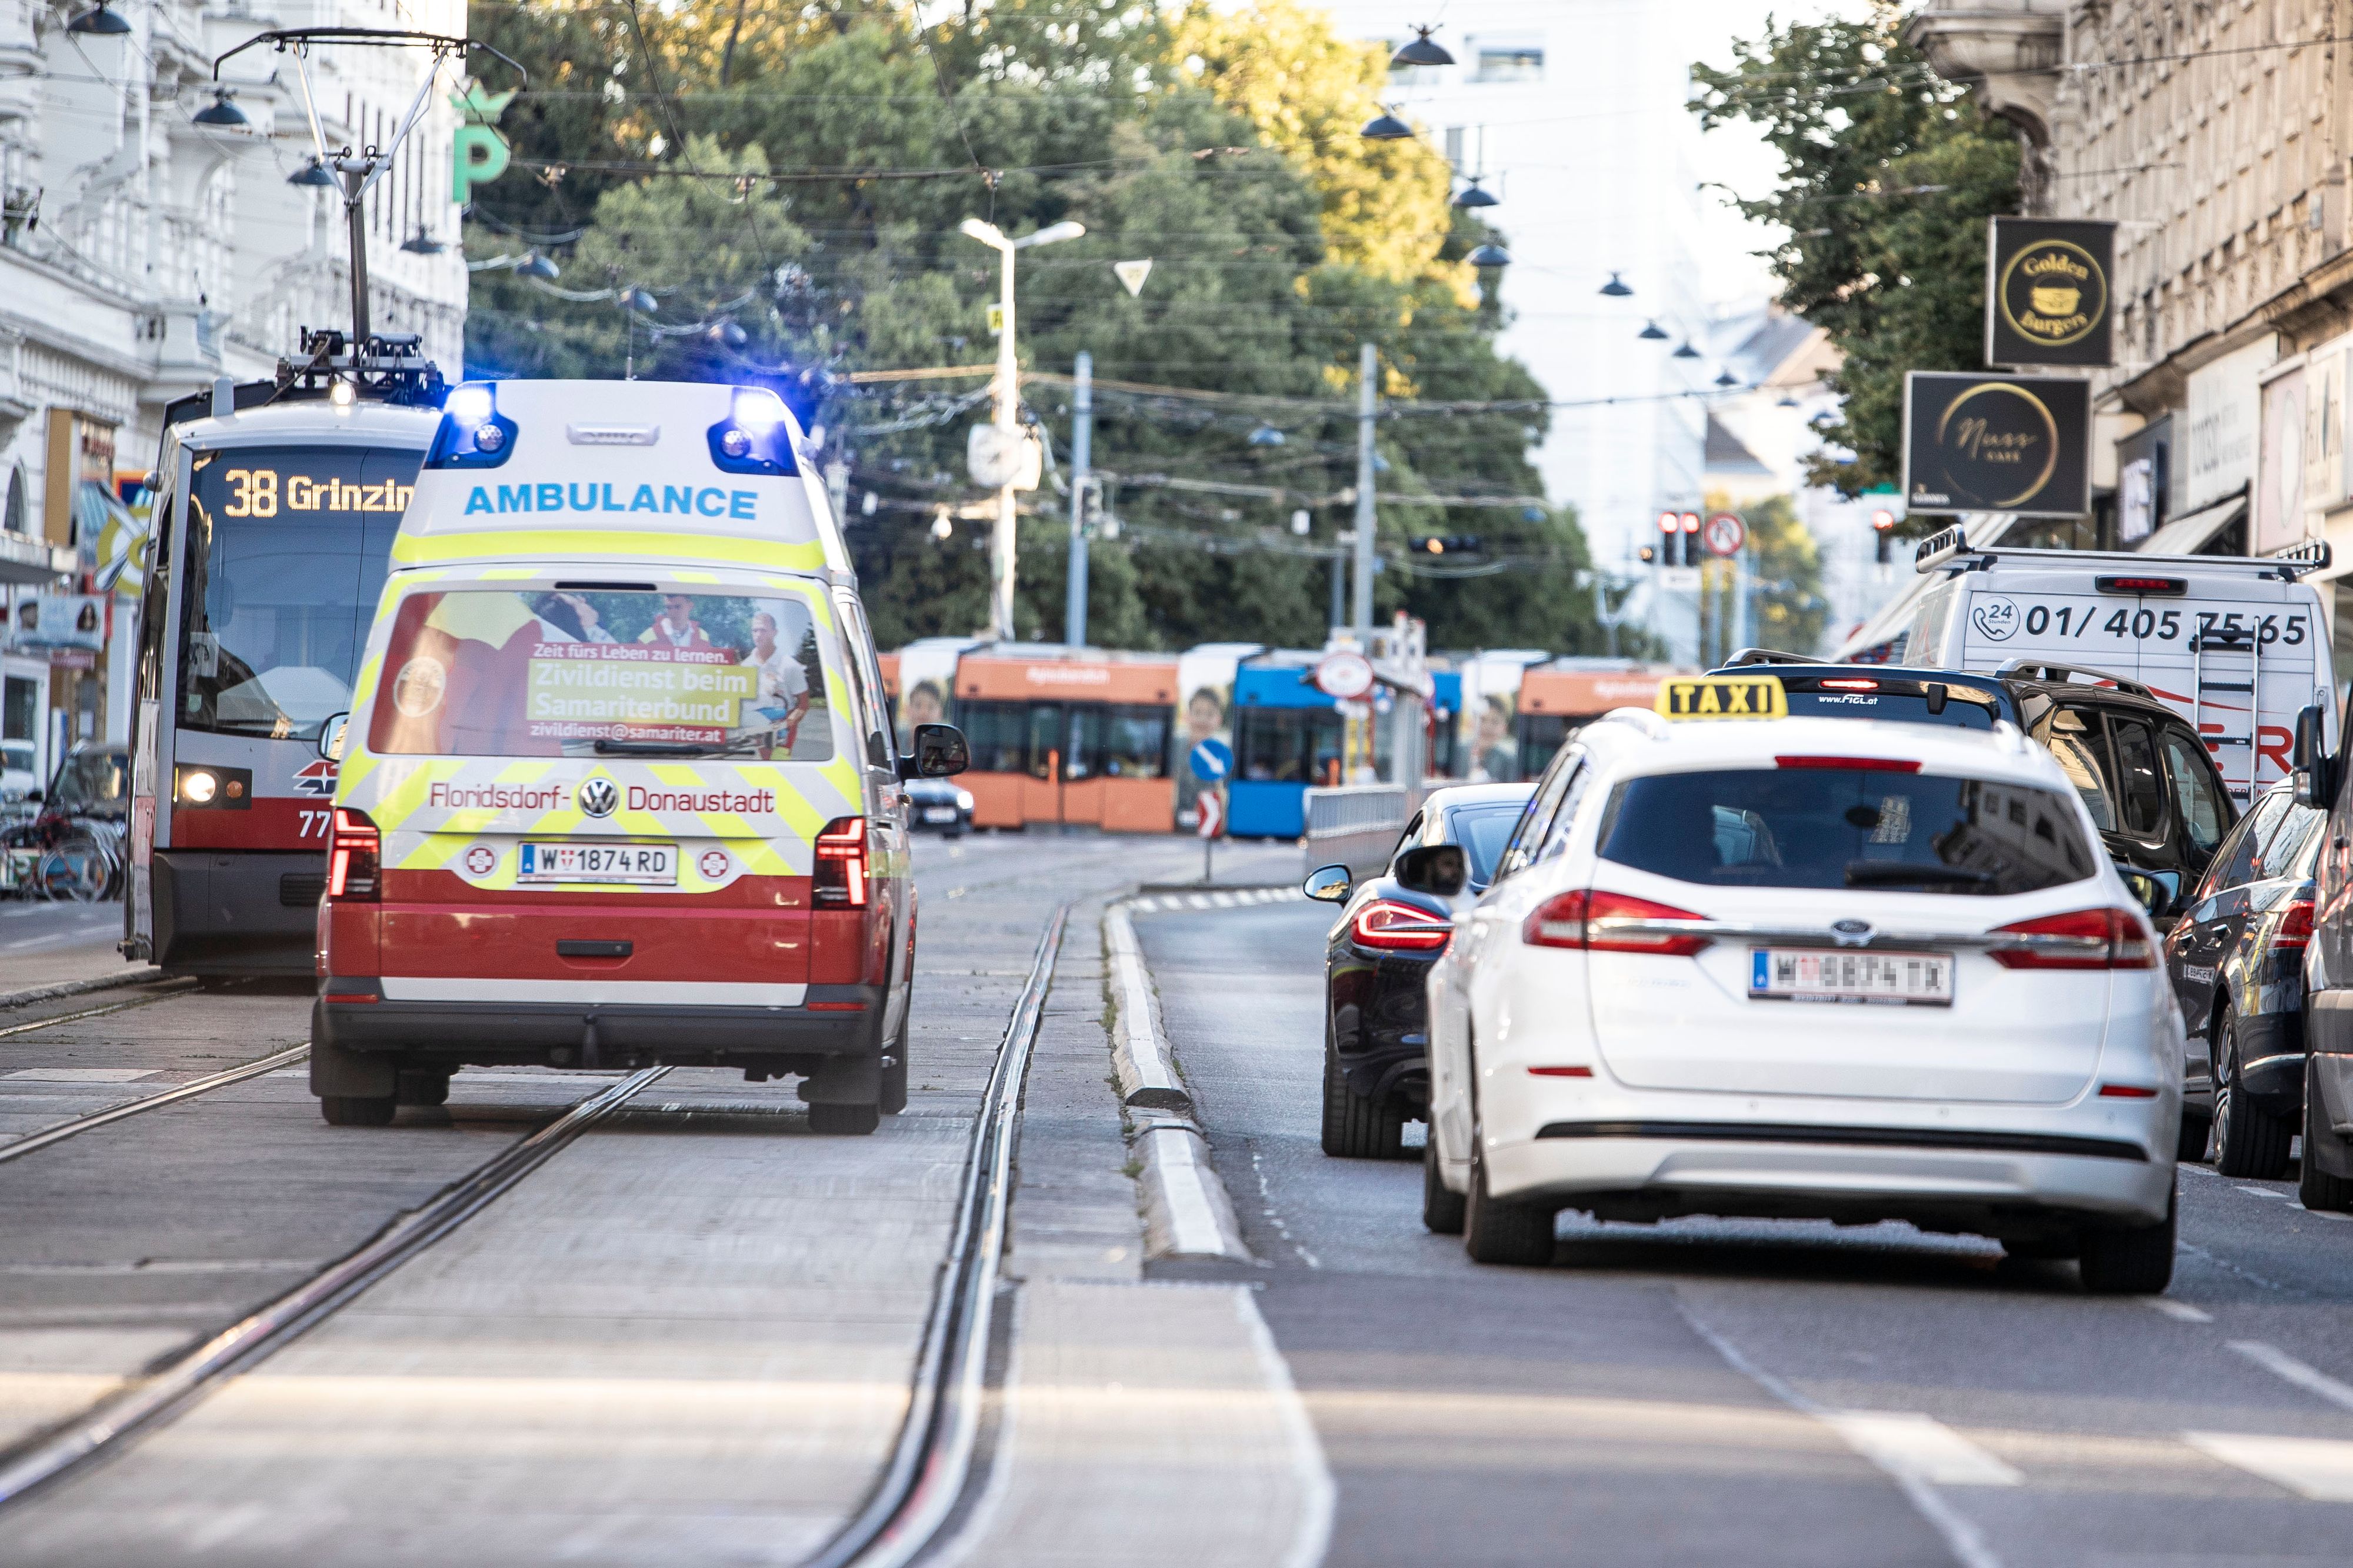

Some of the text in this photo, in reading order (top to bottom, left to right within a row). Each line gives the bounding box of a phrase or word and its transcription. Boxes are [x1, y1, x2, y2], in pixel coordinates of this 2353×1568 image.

[2022, 253, 2089, 281] Golden
[2020, 309, 2088, 338] Burgers
[1957, 416, 2039, 462] Nuss
[225, 469, 278, 518] 38
[464, 482, 759, 521] AMBULANCE
[1989, 604, 2012, 619] 24
[2104, 608, 2182, 640] 405
[534, 643, 729, 665] Zeit fürs Leben zu lernen.
[536, 663, 747, 693] Zivildienst beim
[536, 692, 730, 722] Samariterbund
[1673, 685, 1768, 713] TAXI
[531, 723, 722, 742] zivildienst@samariter.at
[430, 783, 774, 813] Floridsdorf- Donaustadt
[541, 849, 558, 870] W
